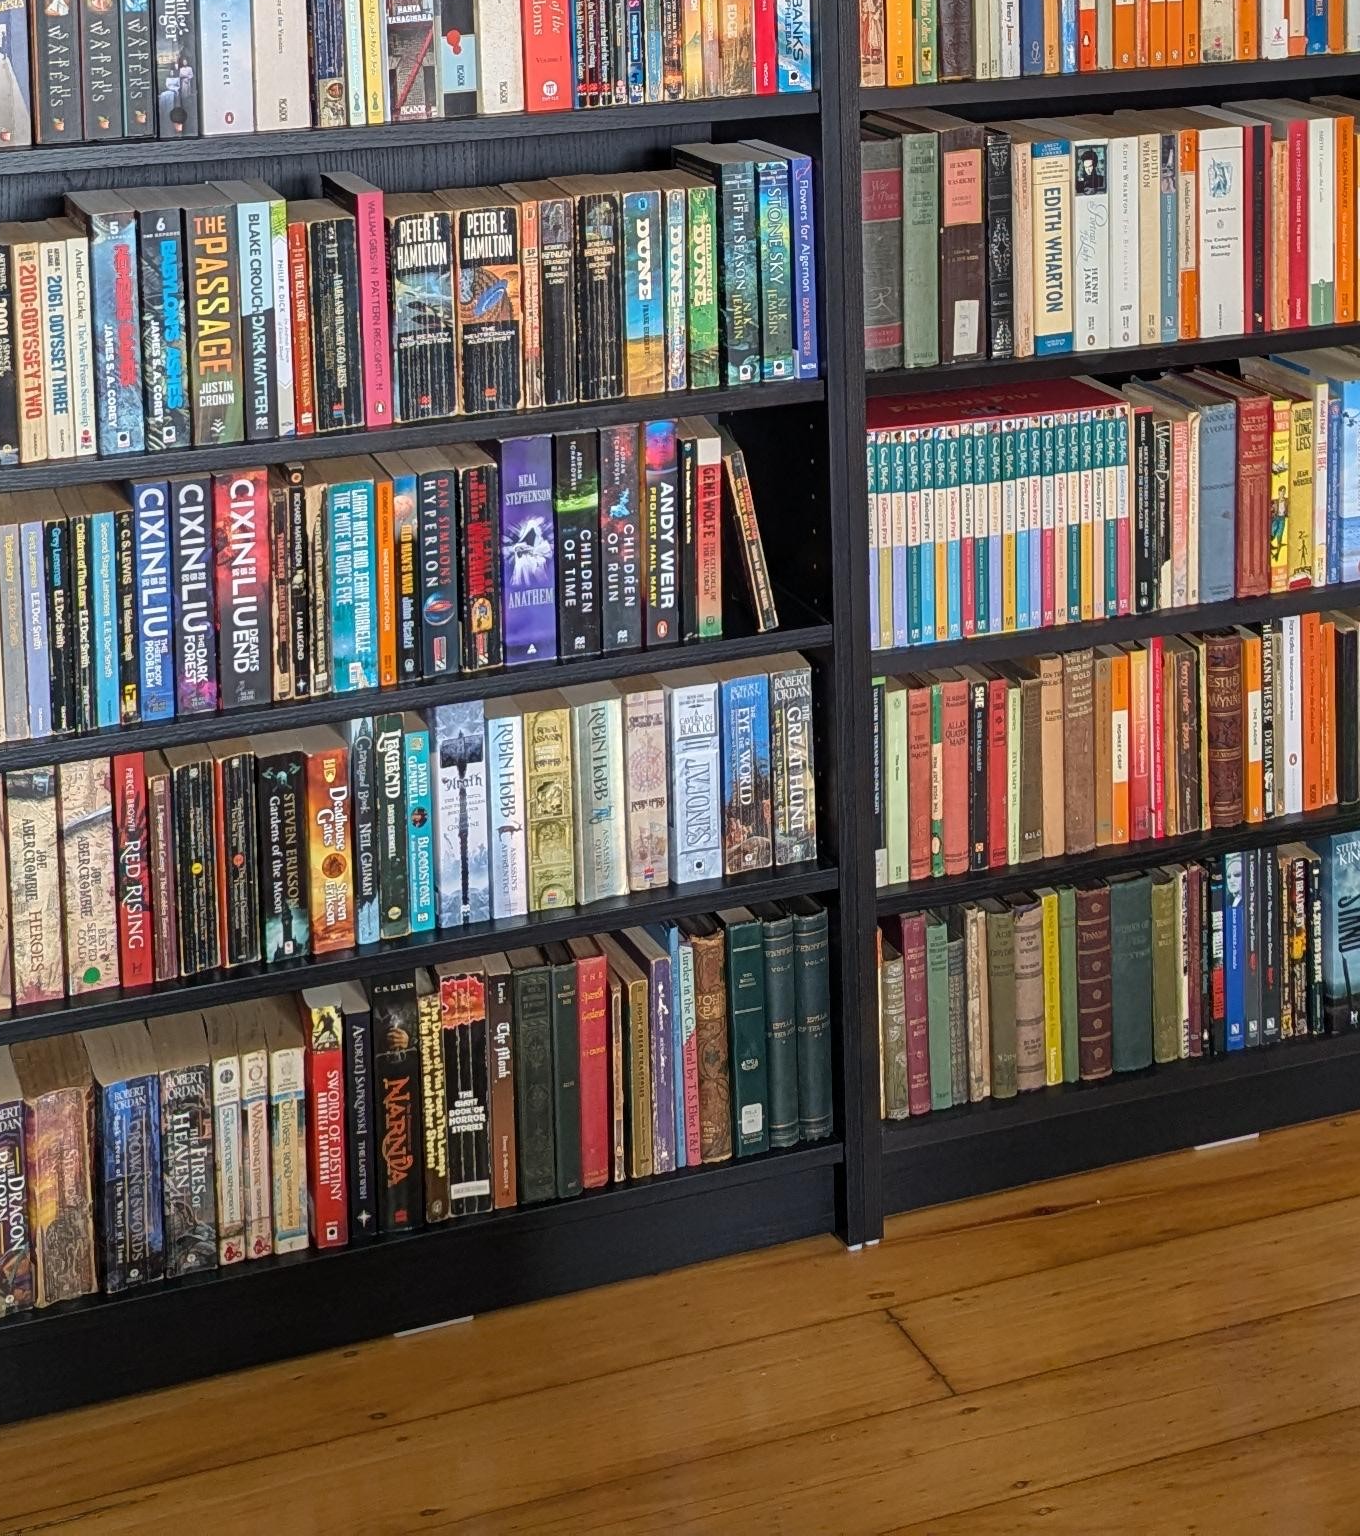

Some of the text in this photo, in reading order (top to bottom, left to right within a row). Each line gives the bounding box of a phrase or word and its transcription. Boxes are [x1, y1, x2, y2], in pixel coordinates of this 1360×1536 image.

[463, 209, 513, 258] PETER F. HAMILTON
[636, 217, 654, 300] DUNE
[1044, 187, 1063, 313] EDITH WHARTON
[194, 215, 232, 374] THE PASSAGE
[199, 380, 234, 407] JUSTIN CRONIN
[229, 478, 257, 629] CIXIN LIU
[423, 479, 438, 588] HYPERION
[608, 524, 636, 608] CHILDREN OF RUIN
[660, 481, 675, 610] ANDY WEIR
[508, 587, 553, 608] ANATHEM
[774, 674, 810, 701] ROBERT JORDAN
[120, 840, 144, 949] RED RISING
